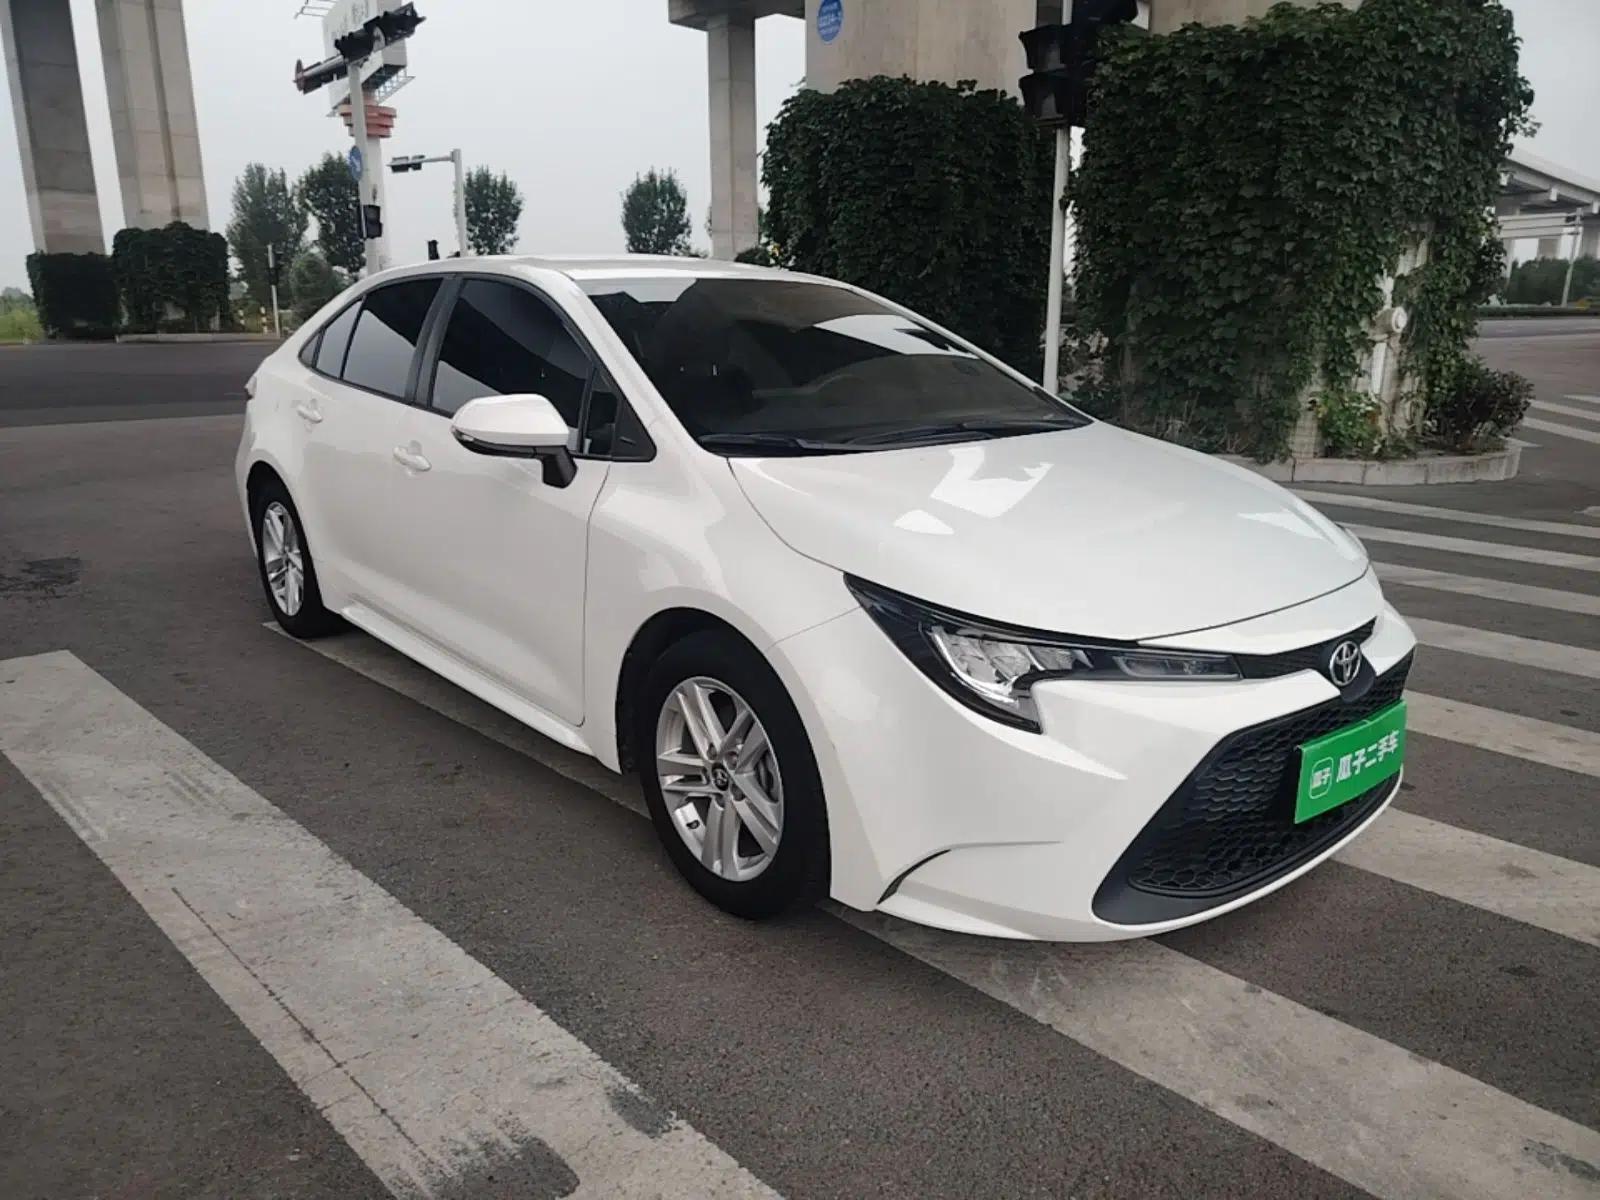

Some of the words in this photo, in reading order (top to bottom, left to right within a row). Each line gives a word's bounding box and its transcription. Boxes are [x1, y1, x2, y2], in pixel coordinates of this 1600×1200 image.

[1336, 730, 1400, 783] 瓜子二手车
